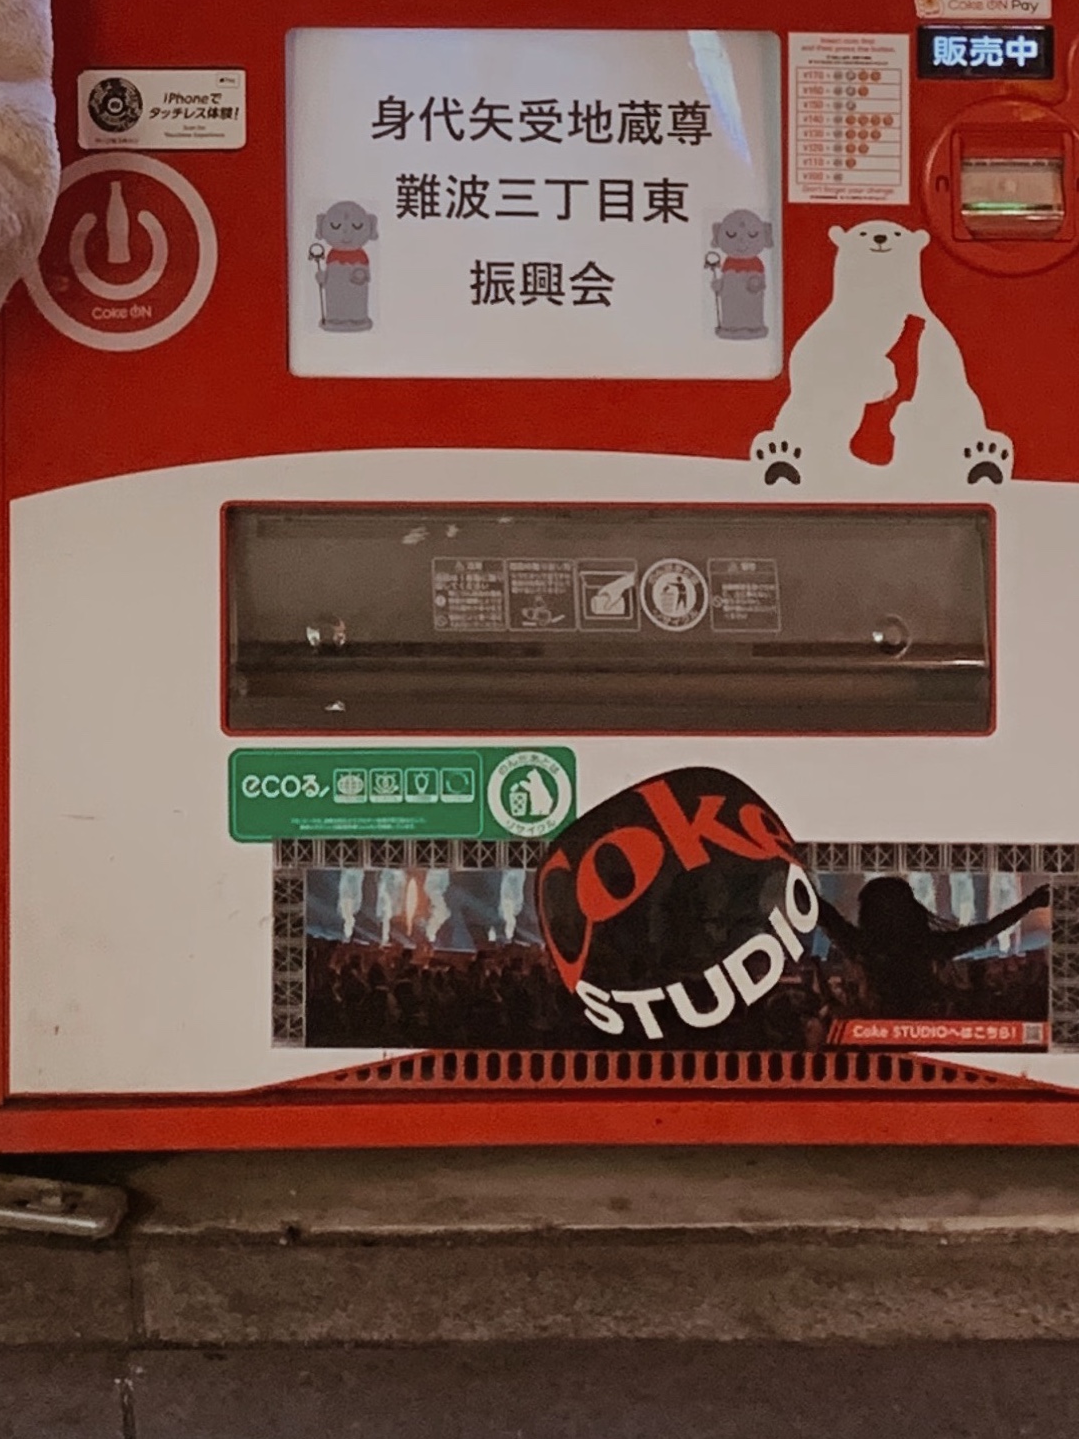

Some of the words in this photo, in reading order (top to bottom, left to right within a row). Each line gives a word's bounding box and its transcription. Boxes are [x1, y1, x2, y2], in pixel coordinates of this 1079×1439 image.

[1011, 0, 1039, 14] Pay
[933, 35, 1038, 67] 販売中
[163, 92, 223, 105] iPhoneで
[149, 106, 240, 121] タッチレス体験!
[372, 95, 712, 146] 身代矢受地蔵尊
[395, 173, 690, 224] 難波三丁目東
[470, 259, 615, 307] 振興会
[91, 307, 127, 320] Coke
[506, 819, 556, 836] リサイクル
[575, 862, 819, 1040] STUDIO
[853, 1025, 889, 1039] Coke
